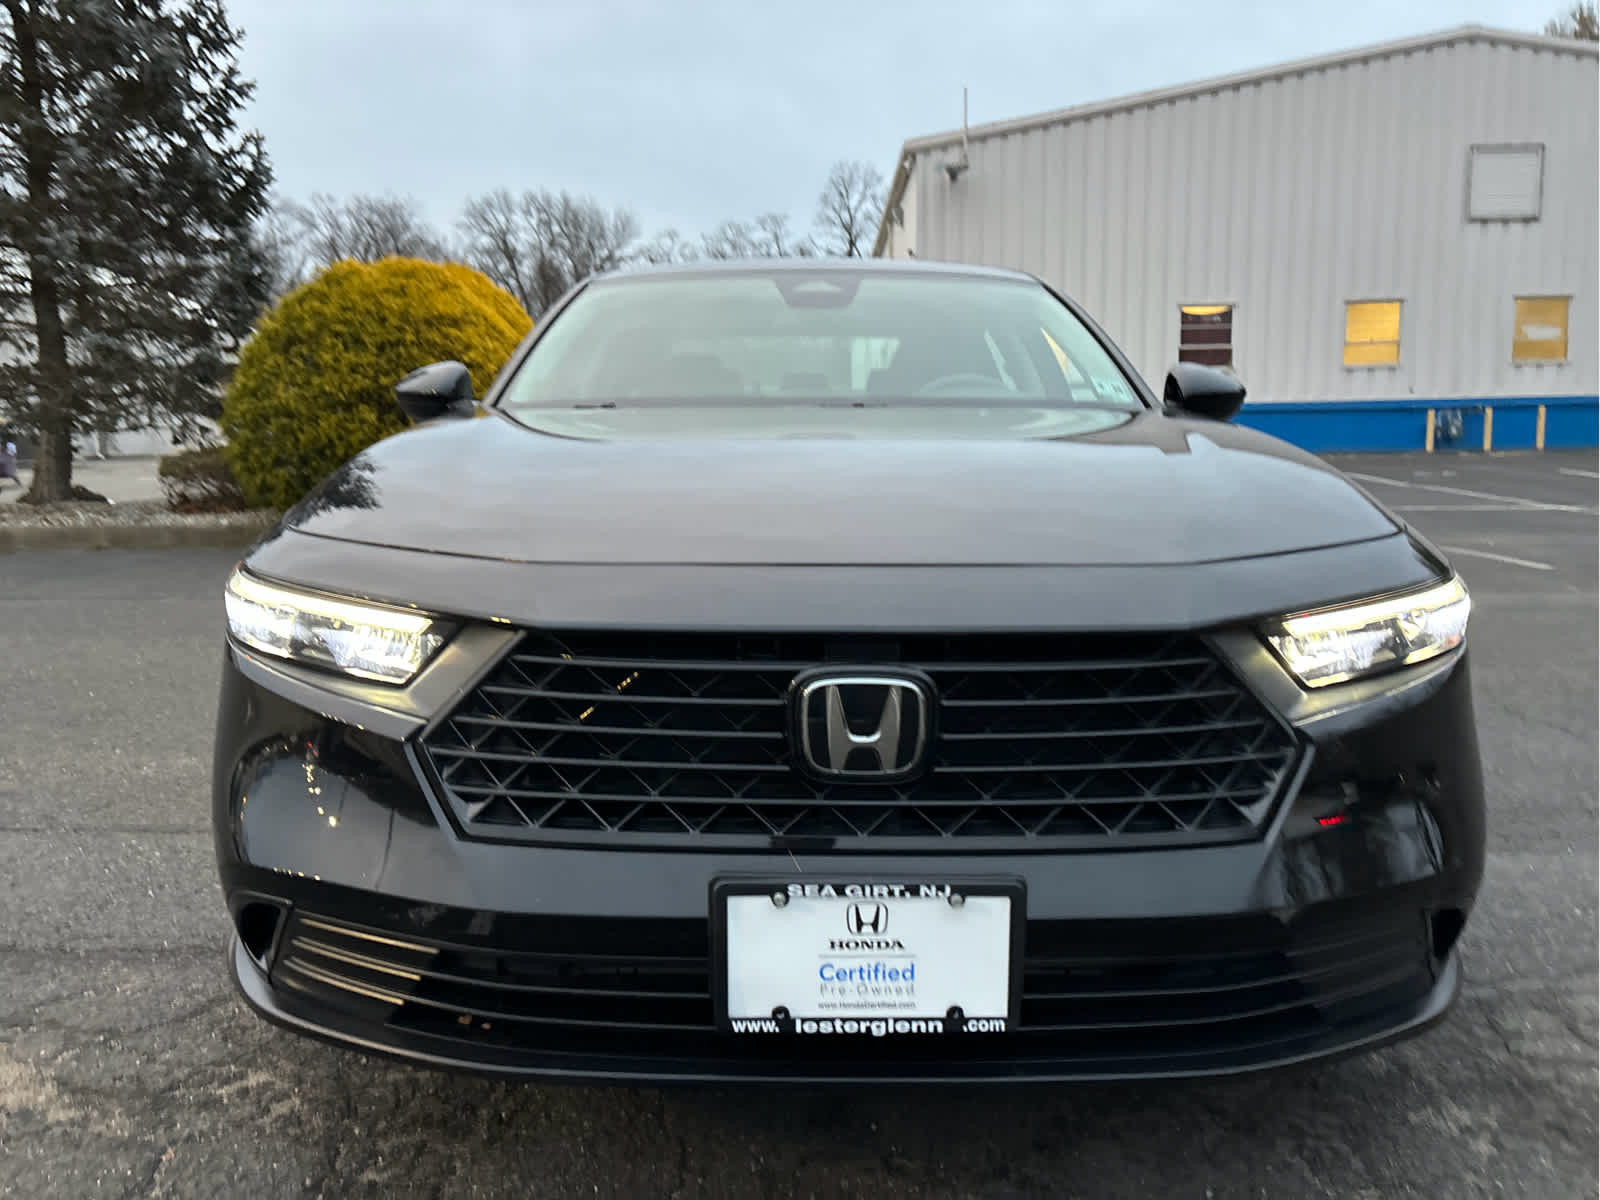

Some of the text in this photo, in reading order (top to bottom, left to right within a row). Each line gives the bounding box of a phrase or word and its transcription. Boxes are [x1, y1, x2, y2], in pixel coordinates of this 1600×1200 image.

[787, 884, 836, 898] SEA
[920, 884, 951, 898] NJ
[829, 938, 905, 950] HONDA
[819, 962, 915, 982] Certified
[820, 983, 915, 996] Pre-Owned
[732, 1018, 1006, 1037] www. lesterglenn .com
